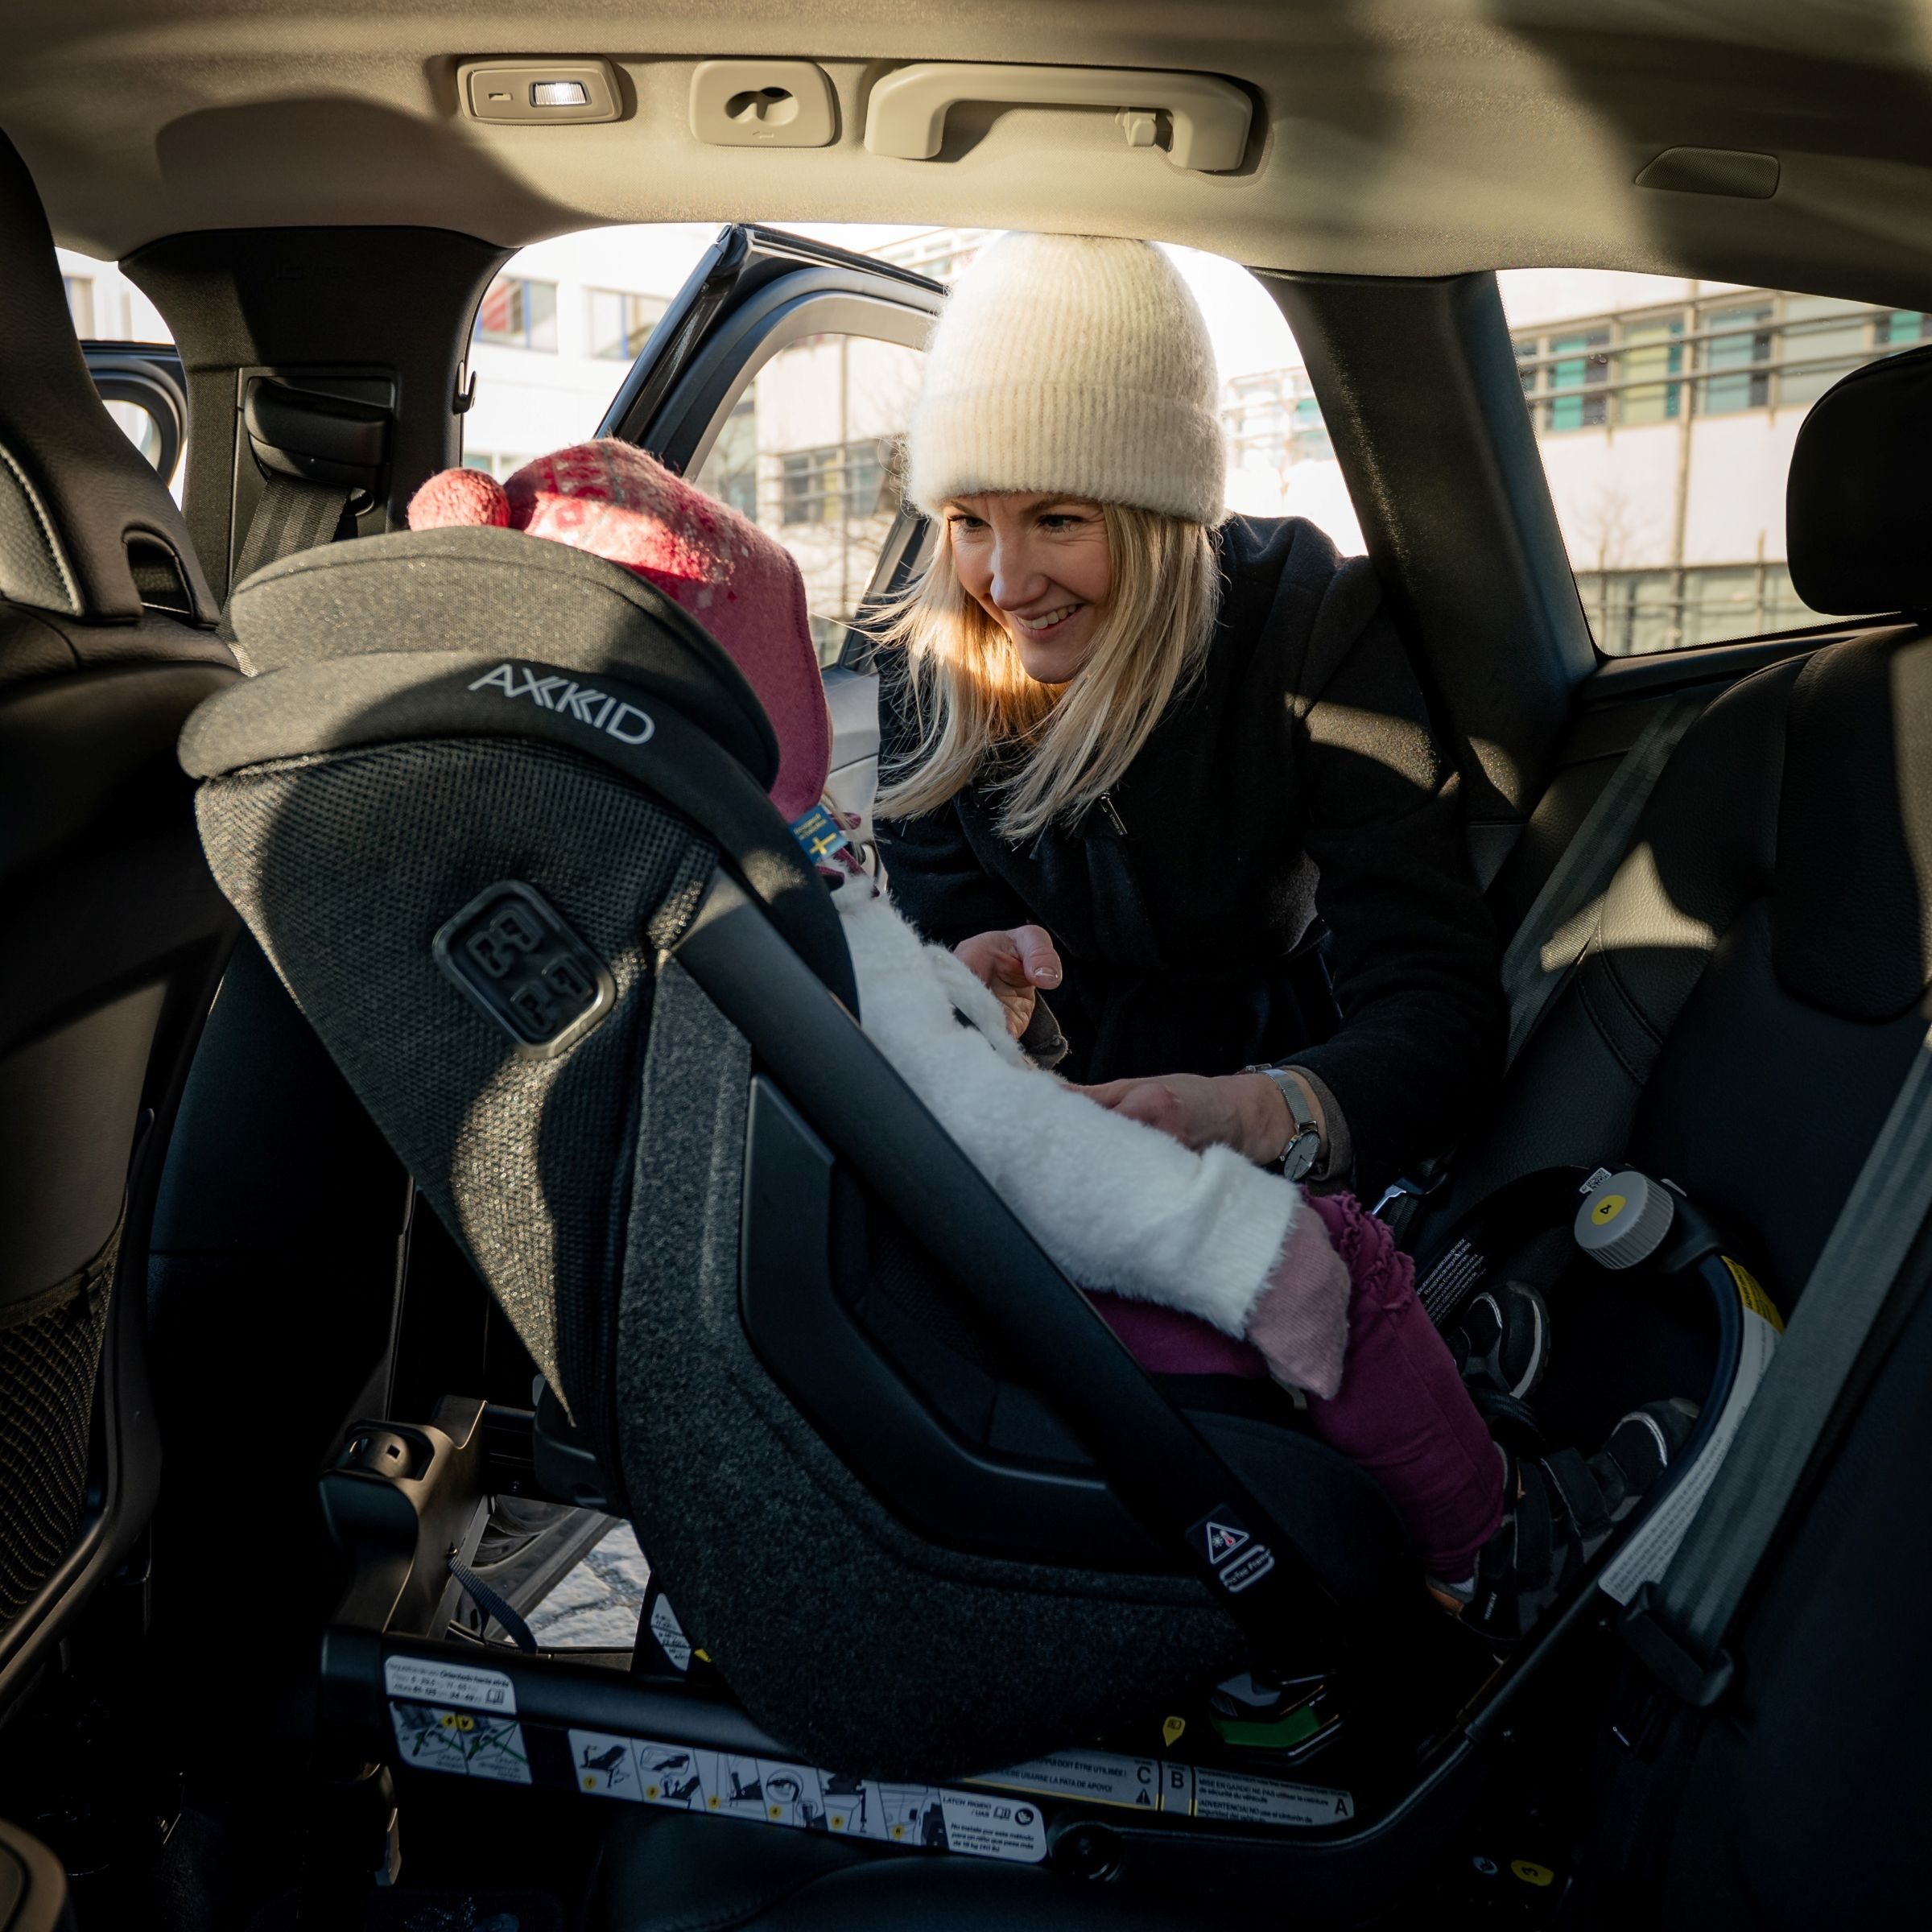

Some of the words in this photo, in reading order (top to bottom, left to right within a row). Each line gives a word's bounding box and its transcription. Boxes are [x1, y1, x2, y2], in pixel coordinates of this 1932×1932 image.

[468, 663, 655, 745] AXKID
[1600, 1204, 1612, 1214] 4
[1137, 1766, 1151, 1784] C
[1171, 1771, 1184, 1790] B
[1335, 1798, 1348, 1816] A
